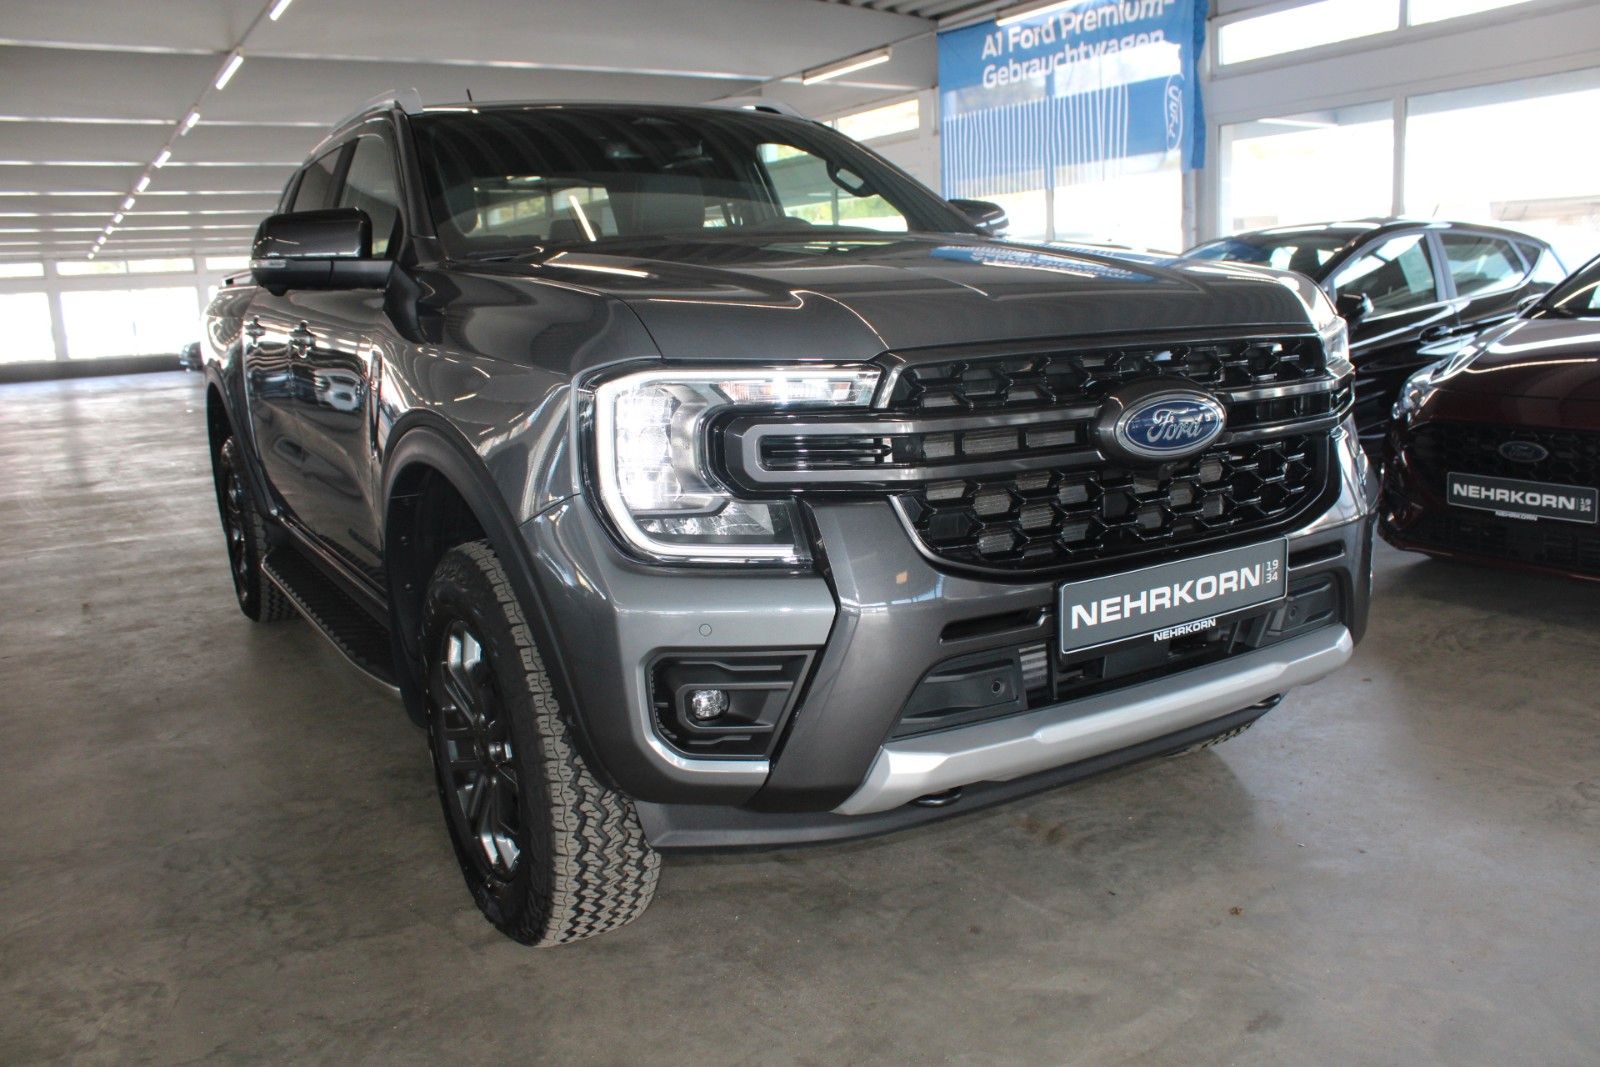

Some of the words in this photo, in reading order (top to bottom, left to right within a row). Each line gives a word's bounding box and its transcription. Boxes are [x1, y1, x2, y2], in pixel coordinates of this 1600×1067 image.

[1007, 15, 1056, 53] Ford
[1146, 407, 1203, 443] Ford
[1453, 483, 1575, 510] NEHRKORN
[1265, 559, 1279, 572] 19
[1265, 570, 1279, 584] 34
[1071, 564, 1261, 630] NEHRKORN
[1153, 617, 1216, 642] NEHRKORN
